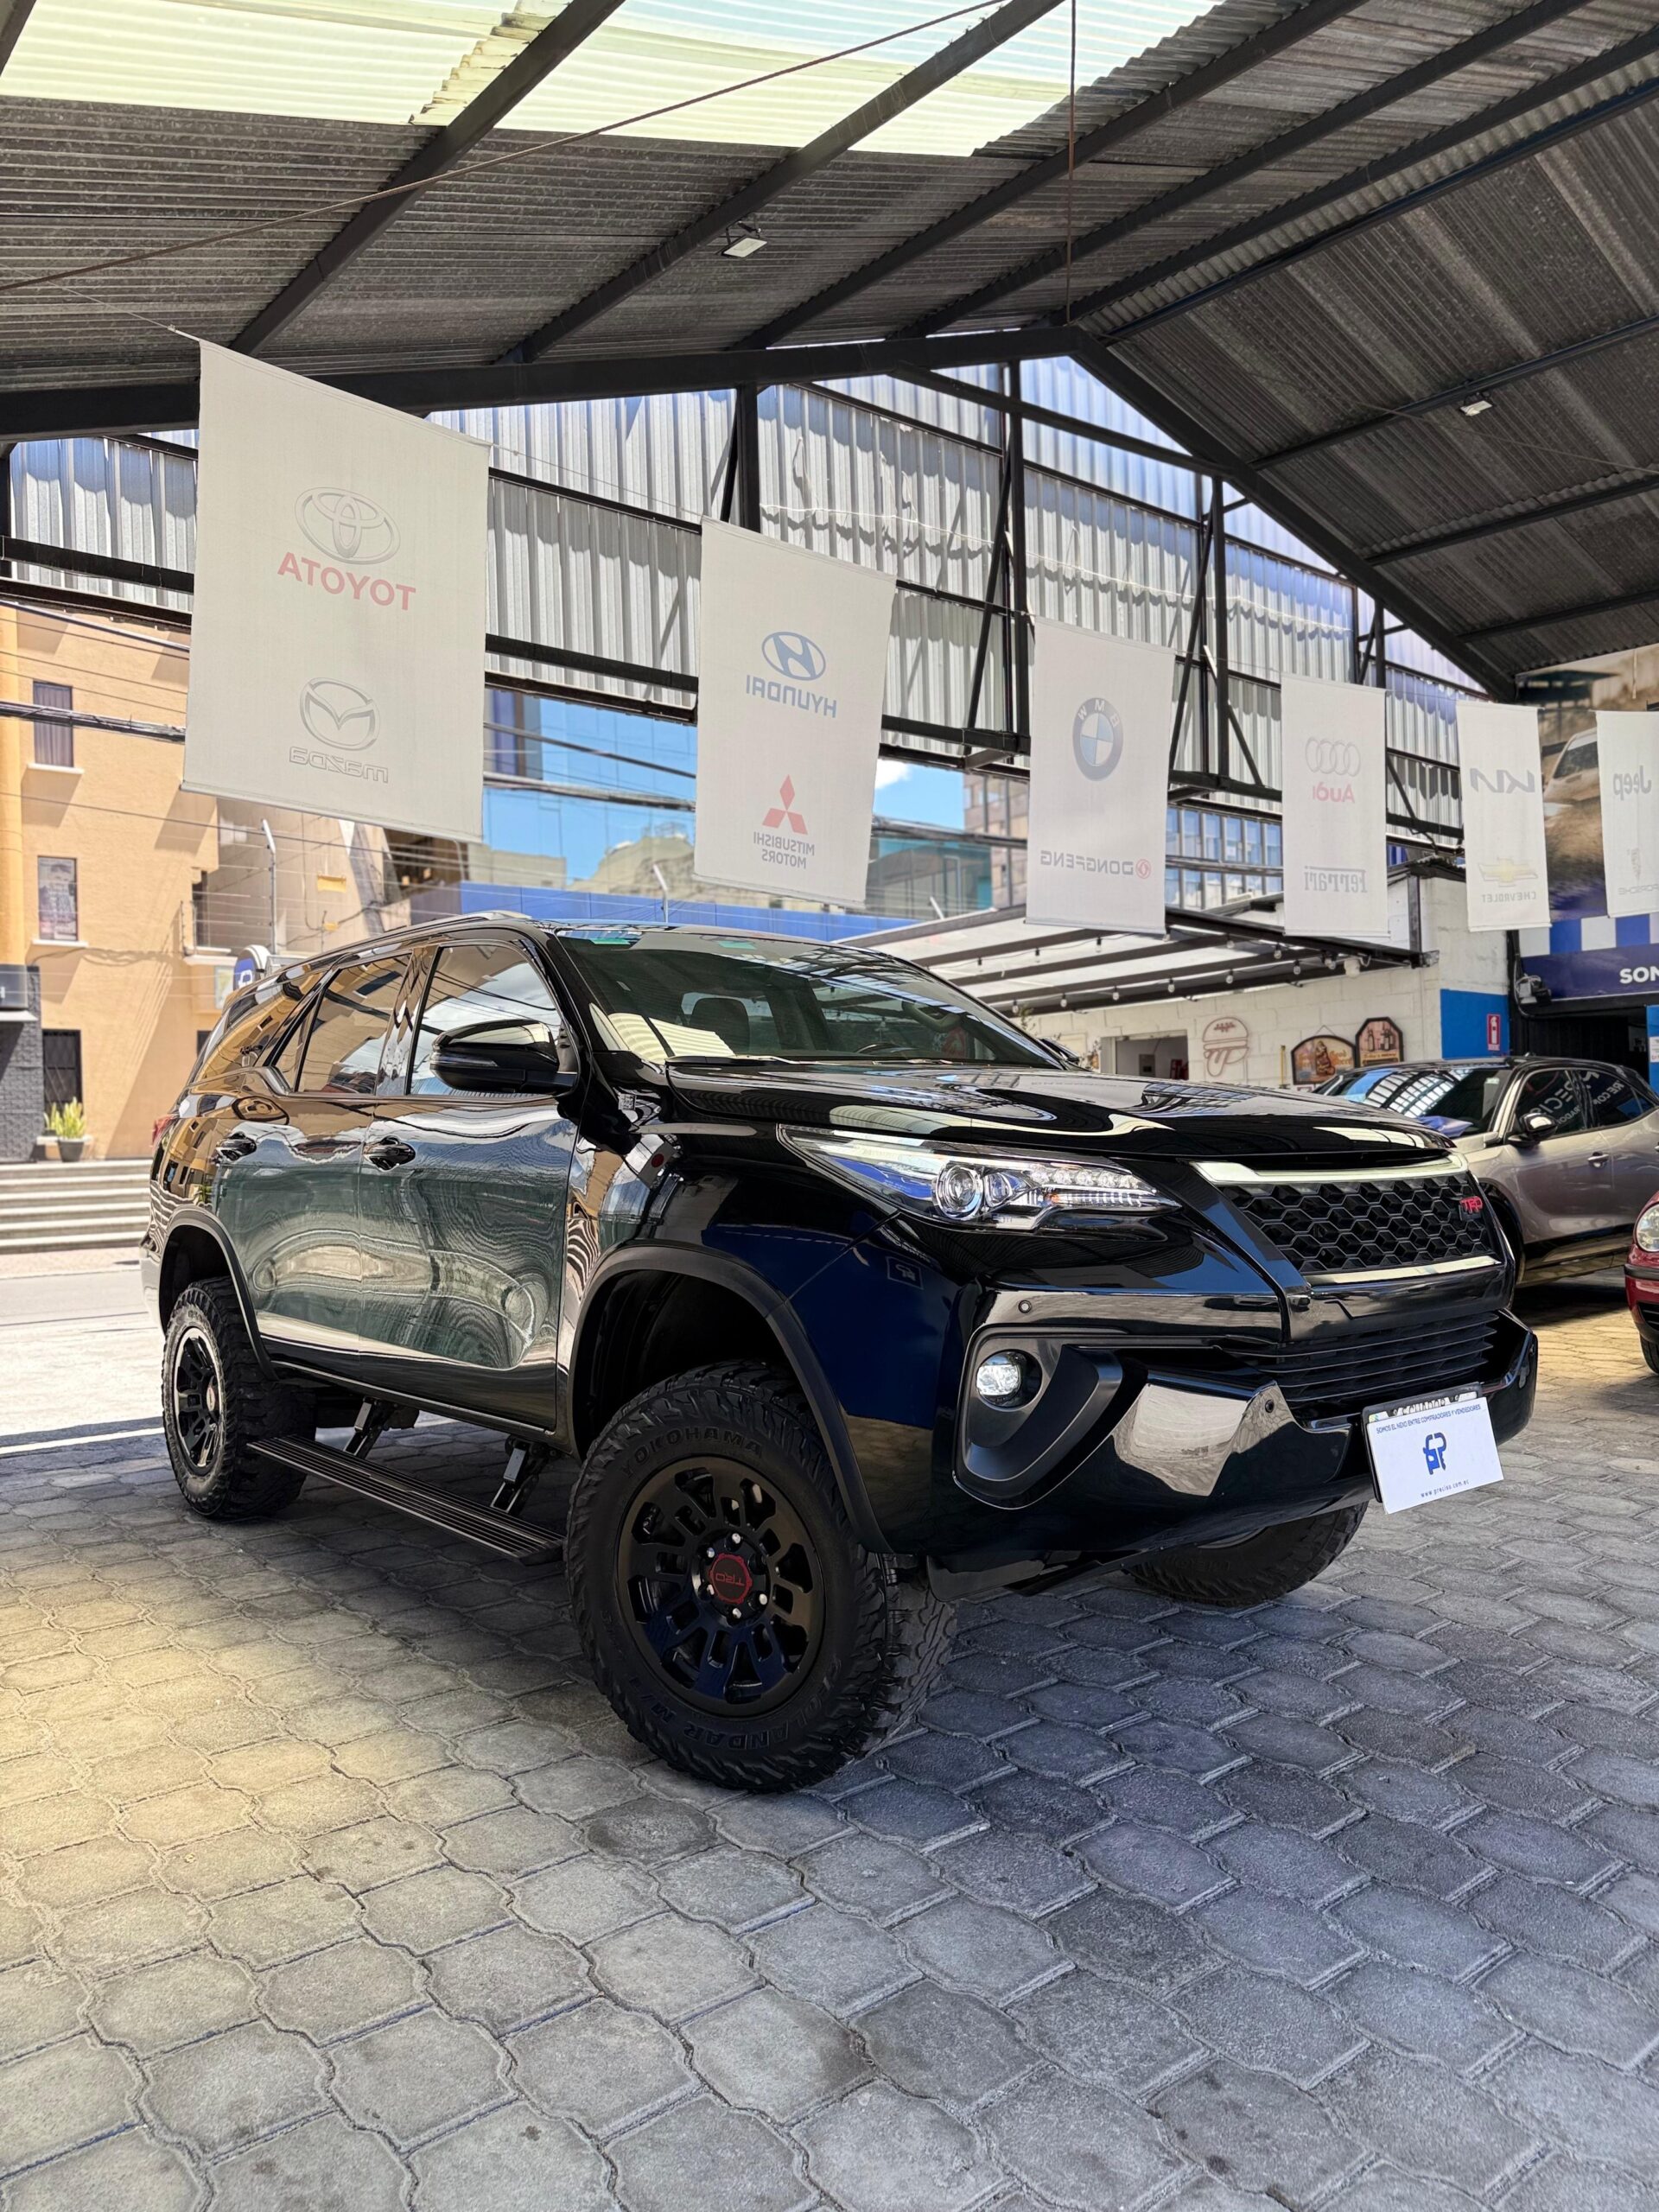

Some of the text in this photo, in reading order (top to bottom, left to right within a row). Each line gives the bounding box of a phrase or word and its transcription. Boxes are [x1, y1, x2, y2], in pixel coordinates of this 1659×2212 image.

[1376, 1425, 1391, 1434] SOMOS
[1396, 1421, 1408, 1430] NEXO
[1408, 1417, 1421, 1427] ENTRE
[1421, 1411, 1452, 1423] COMPRADORES
[1454, 1404, 1481, 1415] VENDEDORES
[622, 1427, 763, 1478] YOKOHAMA
